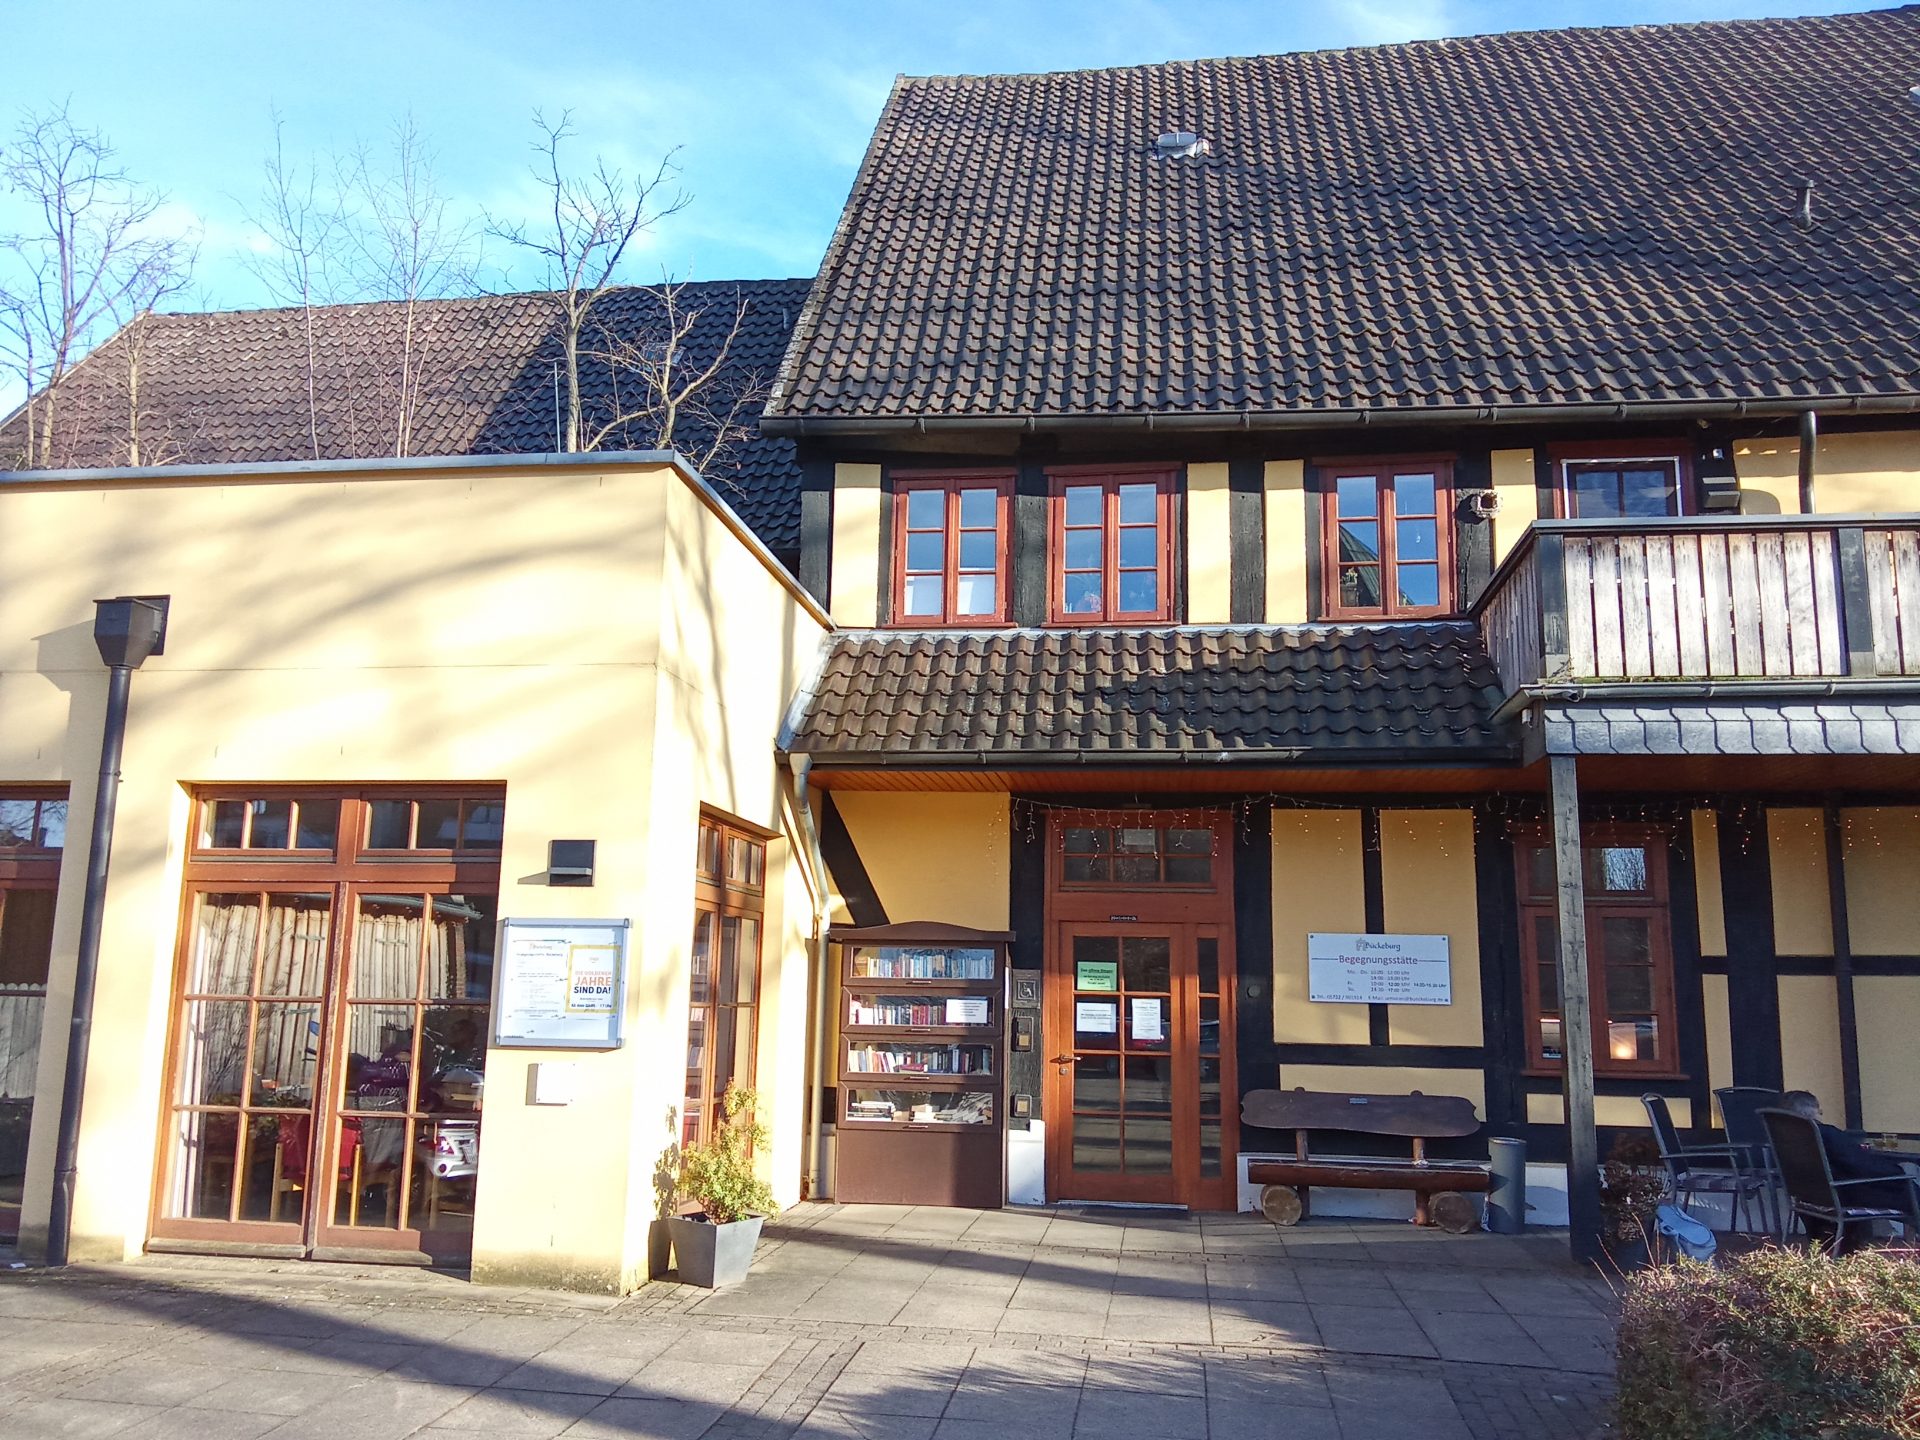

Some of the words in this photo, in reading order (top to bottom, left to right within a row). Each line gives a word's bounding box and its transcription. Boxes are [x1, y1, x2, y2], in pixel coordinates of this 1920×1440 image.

[1339, 955, 1418, 966] Begegnungsstätte
[575, 976, 612, 986] JAHRE
[573, 986, 595, 994] SIND
[596, 986, 611, 995] DA!
